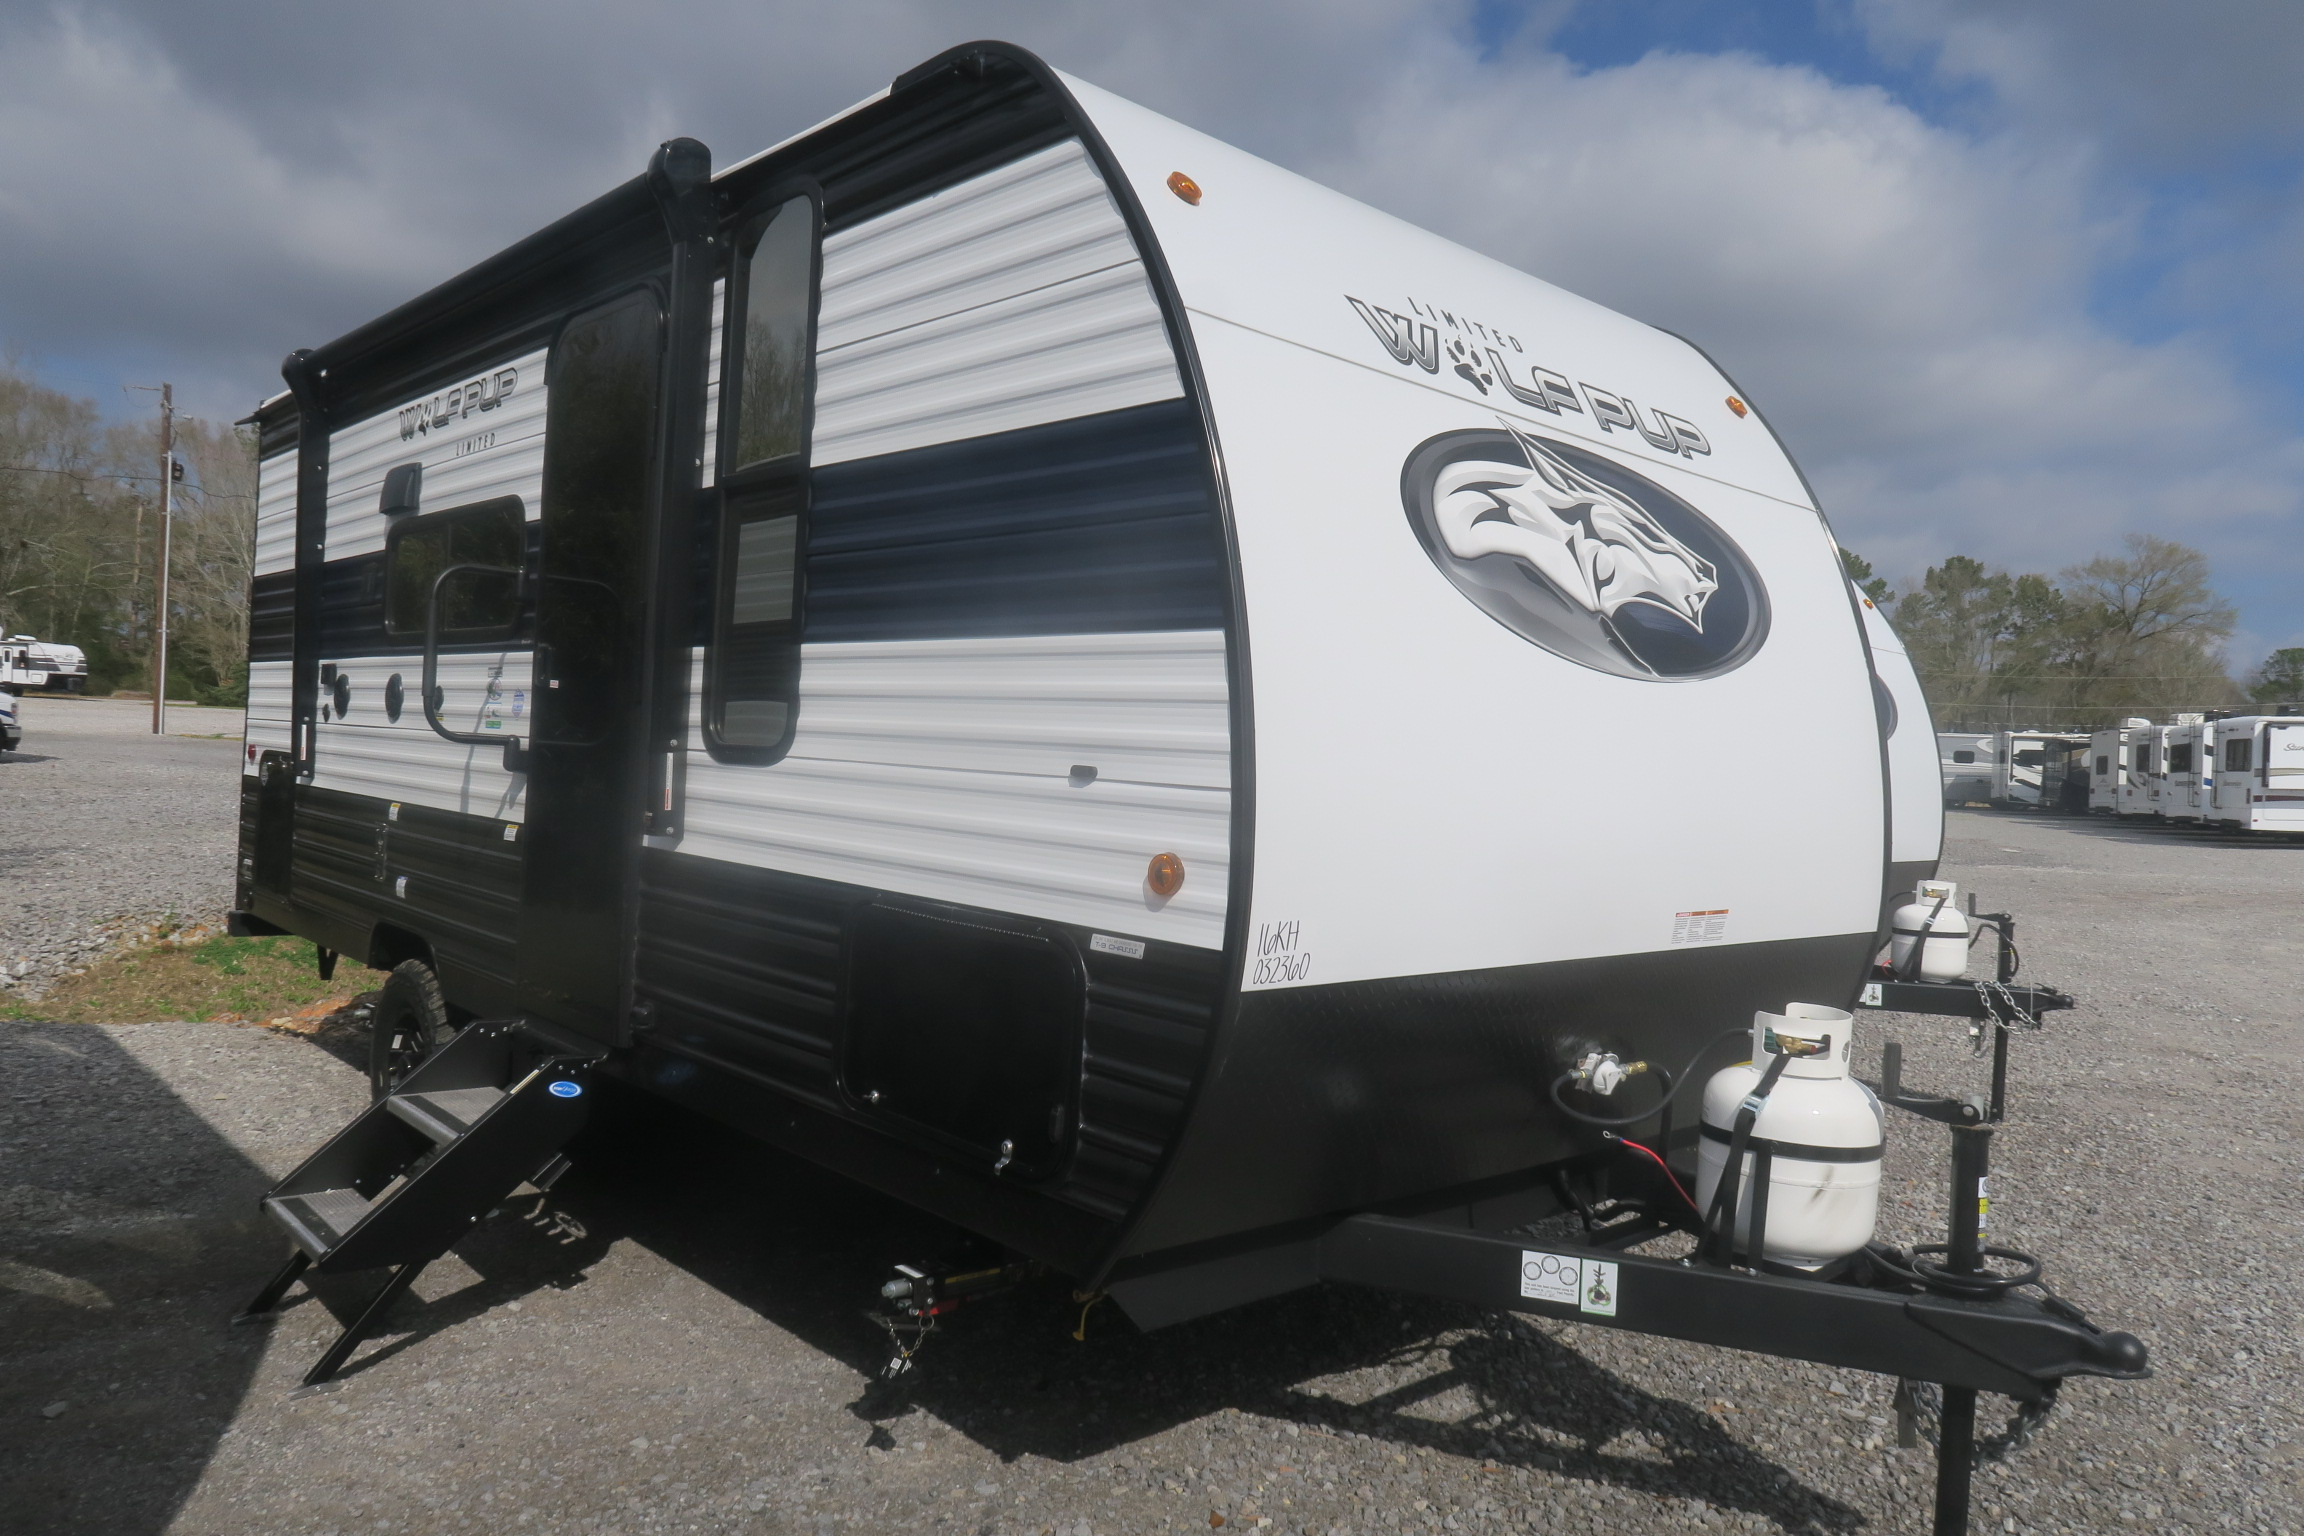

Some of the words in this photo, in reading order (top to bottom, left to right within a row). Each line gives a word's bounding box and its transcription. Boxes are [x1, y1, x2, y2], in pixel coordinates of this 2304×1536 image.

[1407, 296, 1523, 353] LIMITED
[462, 367, 518, 419] PUP
[1578, 381, 1711, 460] PUP
[456, 432, 496, 456] LIMITED
[1257, 920, 1300, 957] 16KH
[1253, 952, 1311, 985] 032360
